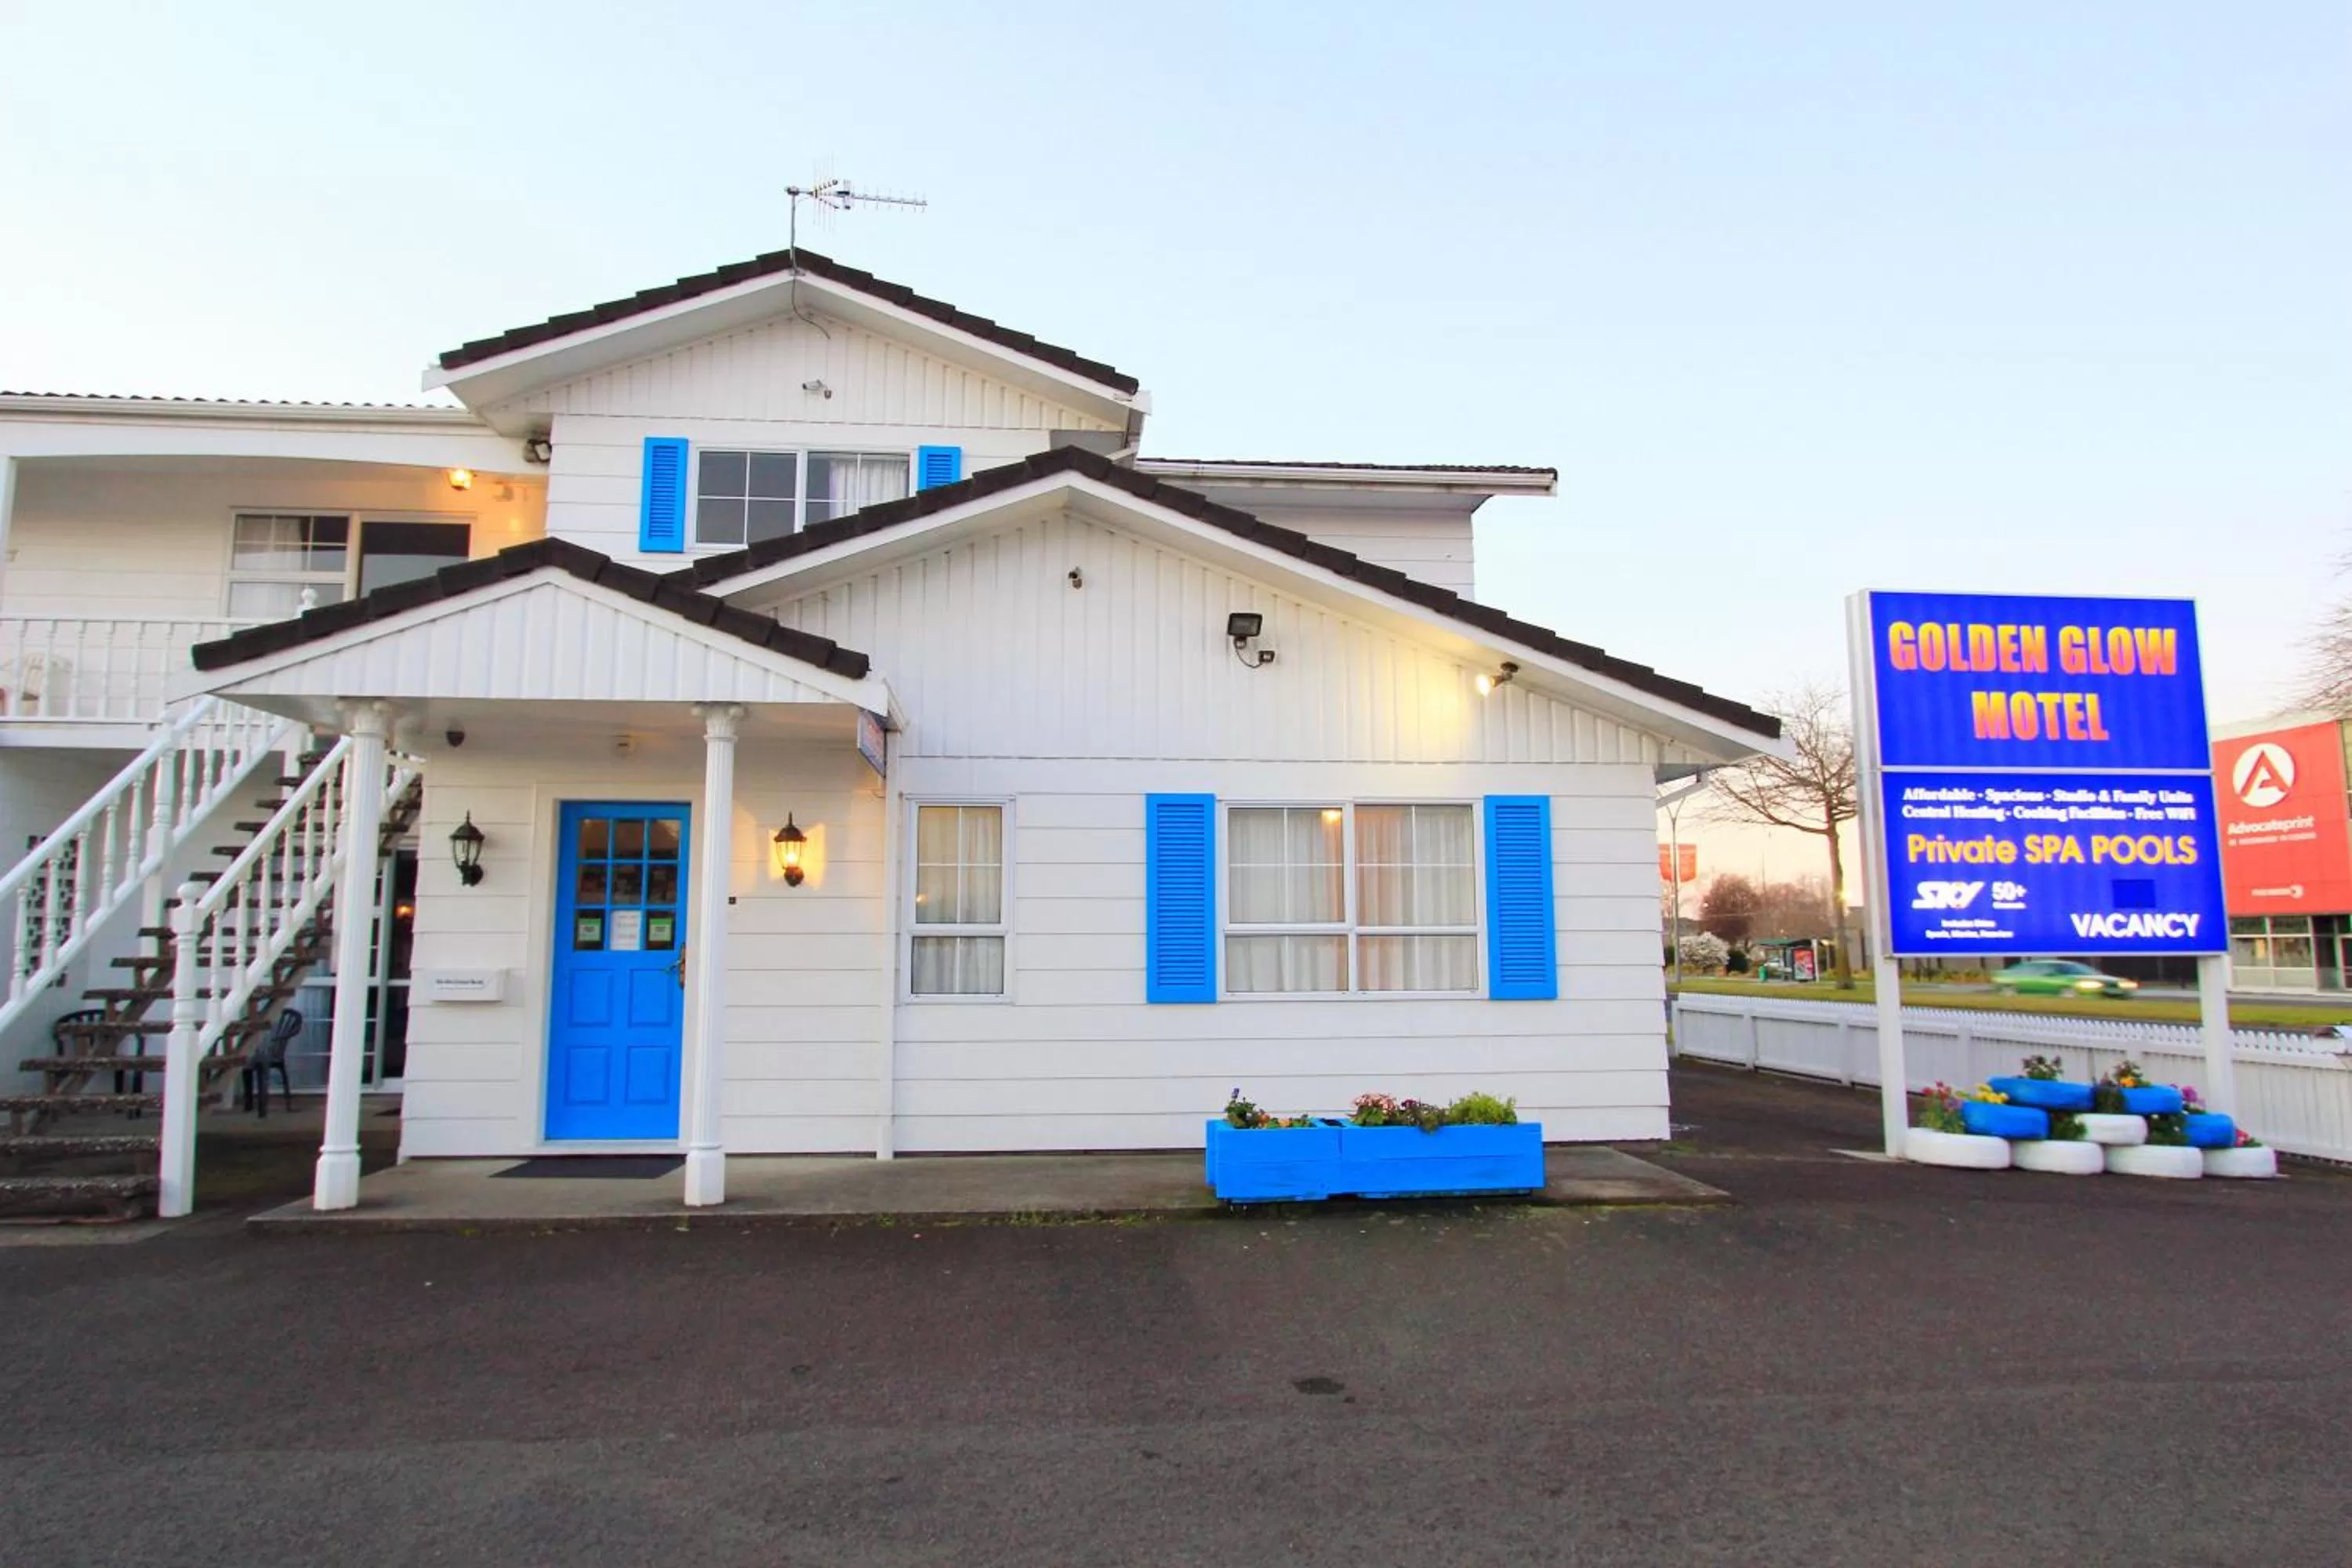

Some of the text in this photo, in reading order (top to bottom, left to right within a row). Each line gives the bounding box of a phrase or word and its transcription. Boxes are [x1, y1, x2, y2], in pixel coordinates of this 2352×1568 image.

[1889, 622, 2176, 674] GOLDEN GLOW
[1972, 691, 2108, 740] MOTEL
[1904, 789, 2194, 805] Affordable Spacious Studio & Family Units
[1903, 805, 1951, 818] Central
[1953, 806, 2005, 822] Heating
[2013, 806, 2068, 822] Cooking
[2068, 806, 2127, 819] Facilities
[2135, 808, 2164, 819] Free
[1907, 834, 2018, 864] Private
[2024, 834, 2085, 864] SPA
[2092, 835, 2198, 865] POOLS
[1992, 881, 2027, 901] 50+
[2071, 913, 2199, 938] VACANCY
